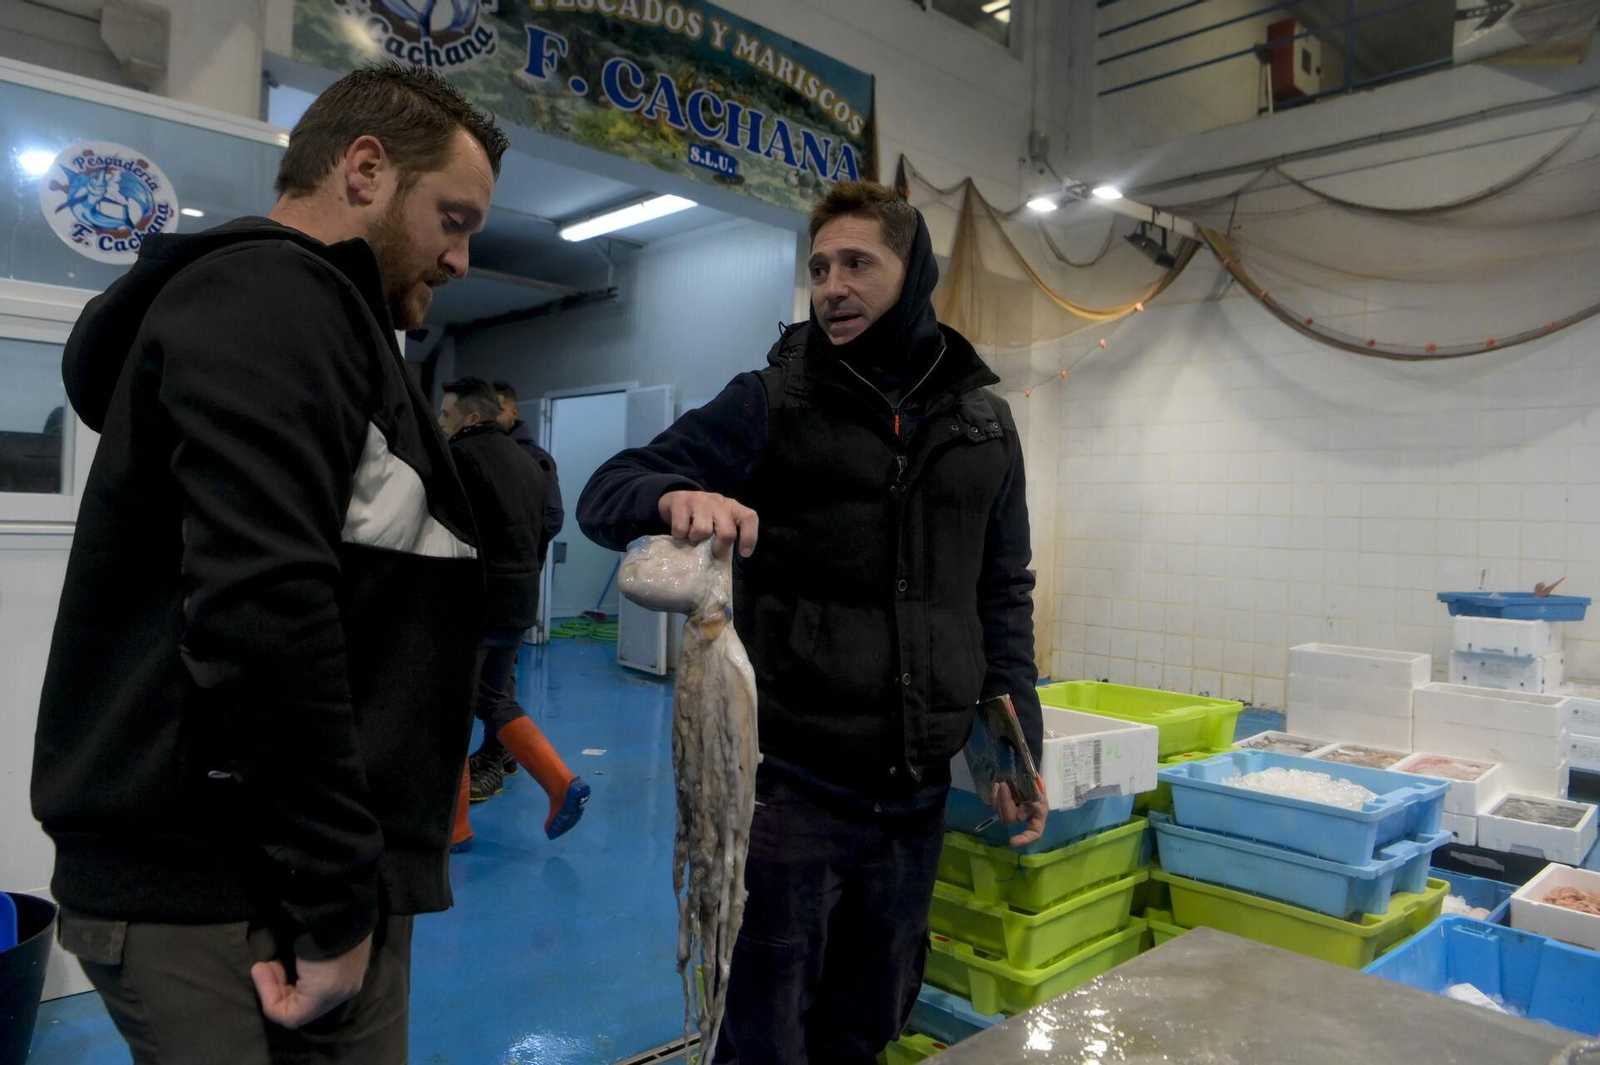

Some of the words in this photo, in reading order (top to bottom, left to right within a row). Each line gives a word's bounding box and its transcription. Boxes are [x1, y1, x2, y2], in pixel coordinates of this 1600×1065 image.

[524, 25, 588, 96] F.
[602, 57, 860, 182] CACHANA
[533, 0, 702, 38] CADOS
[711, 21, 729, 49] Y
[735, 33, 864, 136] MARISCOS
[690, 146, 734, 174] S.L.U.
[72, 223, 93, 246] F.
